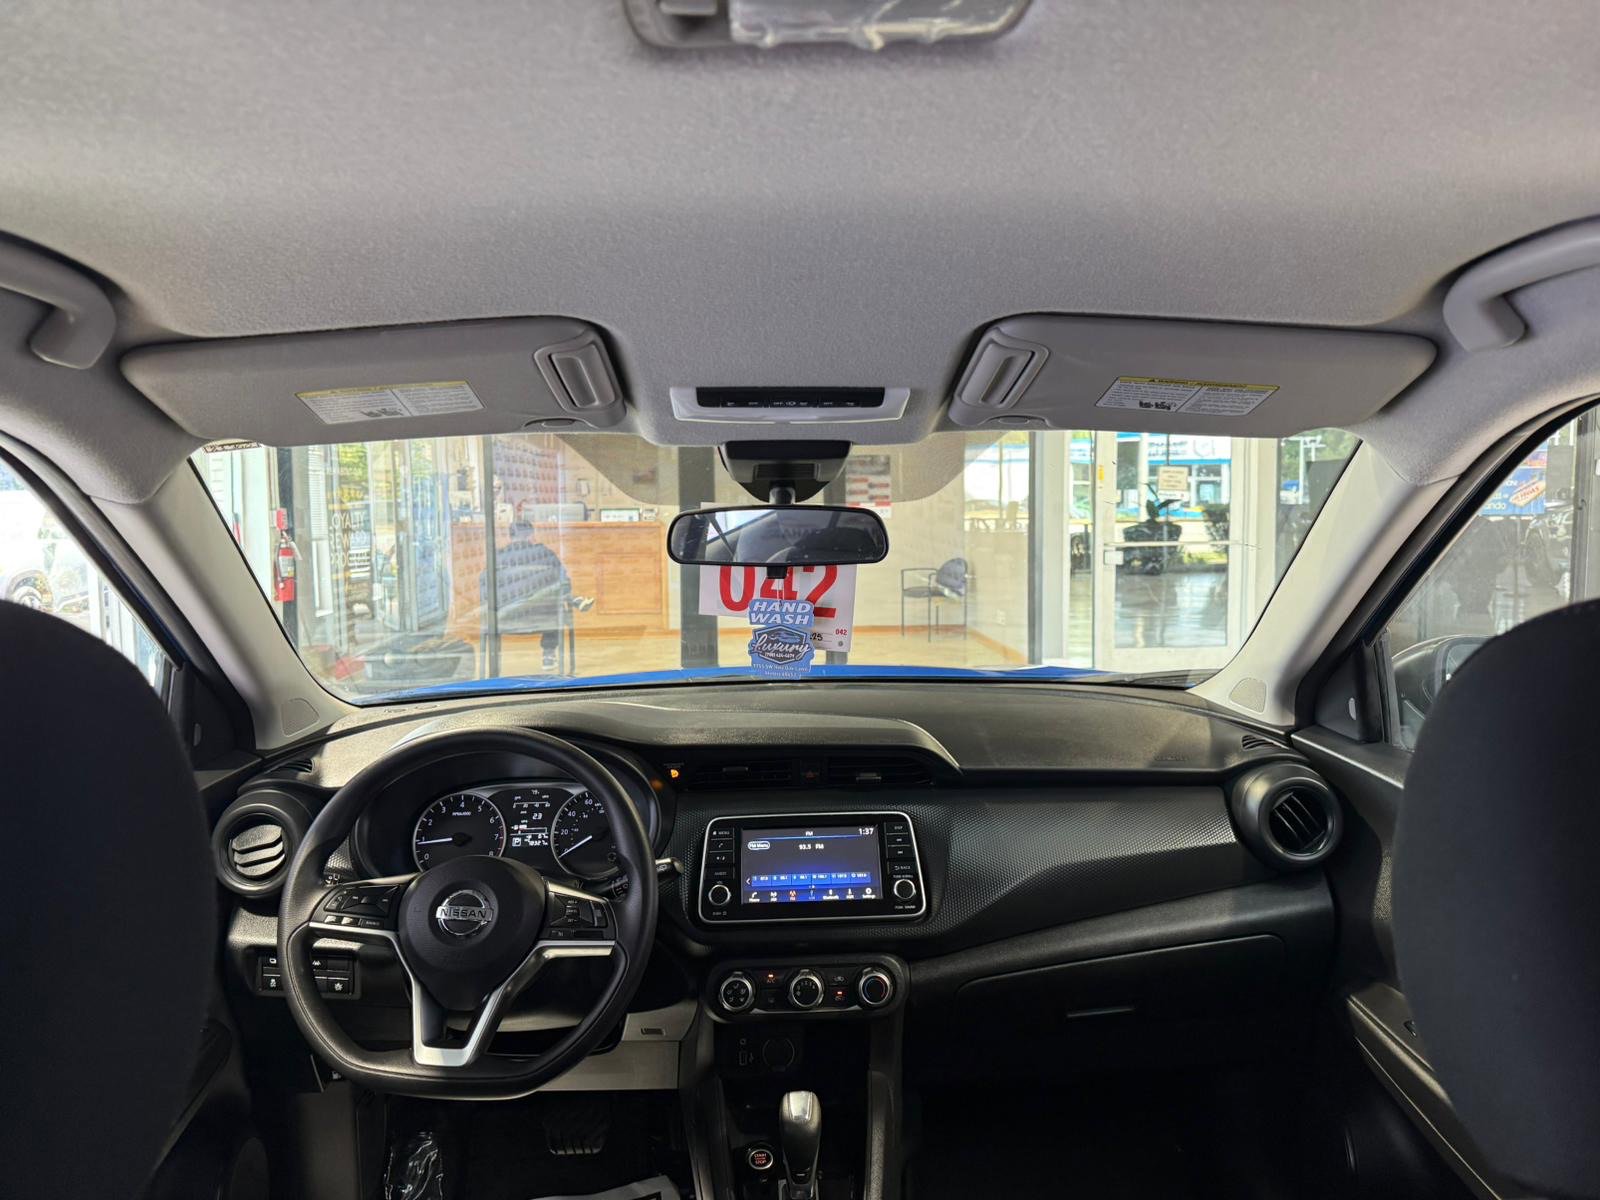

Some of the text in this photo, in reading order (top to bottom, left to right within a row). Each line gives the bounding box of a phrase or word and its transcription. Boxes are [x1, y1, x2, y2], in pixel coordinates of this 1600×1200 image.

[753, 601, 811, 613] HAND
[750, 613, 810, 625] WASH
[835, 628, 848, 636] 042
[560, 828, 569, 836] 20
[859, 827, 874, 835] 1:37
[440, 907, 487, 918] NISSAN
